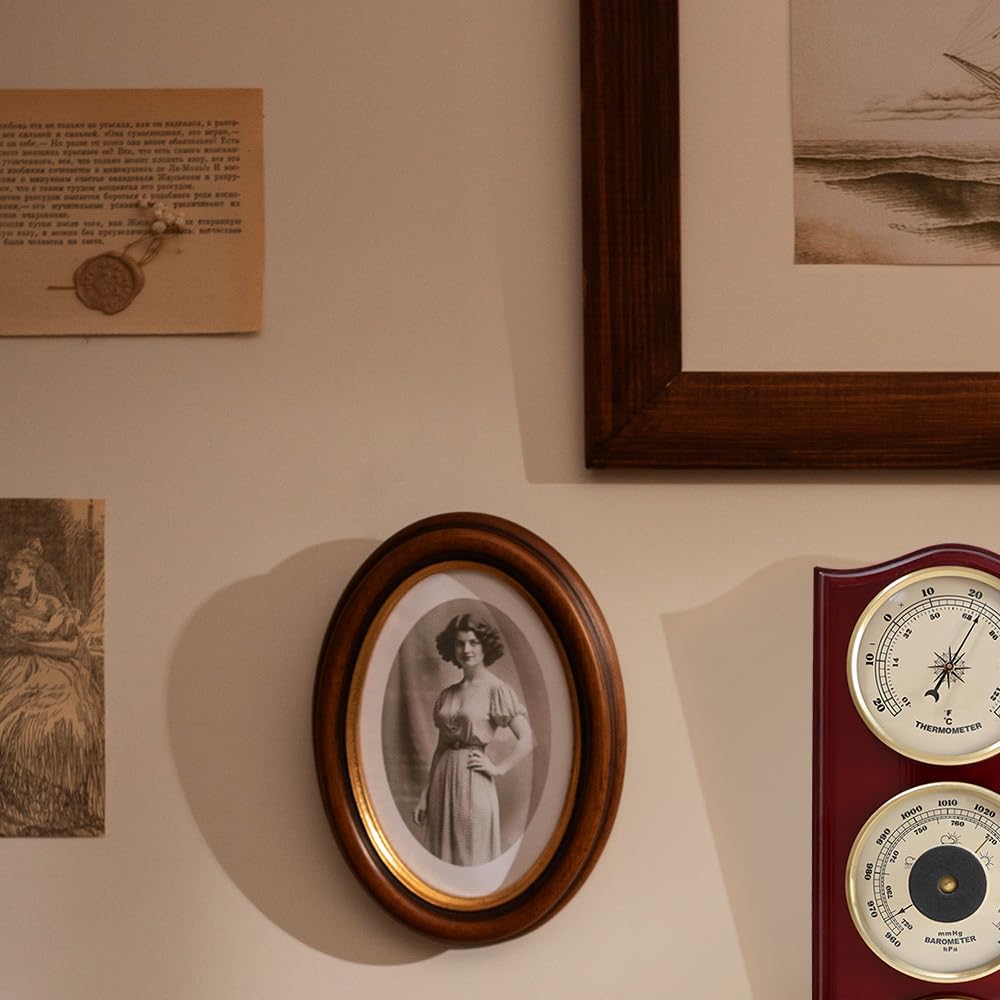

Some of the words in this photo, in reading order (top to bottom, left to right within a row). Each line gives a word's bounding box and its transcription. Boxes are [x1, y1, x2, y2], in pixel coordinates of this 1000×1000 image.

[921, 586, 935, 598] 10
[967, 588, 984, 600] 20
[883, 613, 893, 622] 0
[929, 612, 941, 621] 50
[865, 653, 875, 666] 10
[892, 657, 900, 668] 14
[872, 697, 886, 713] 20
[915, 720, 982, 734] THERMOMETER
[938, 799, 958, 807] 1010
[901, 805, 923, 820] 1000
[974, 803, 996, 818] 1020
[875, 828, 891, 846] 990
[914, 825, 928, 836] 750
[889, 850, 899, 863] 740
[864, 863, 874, 880] 980
[866, 900, 878, 918] 970
[884, 931, 902, 948] 960
[924, 935, 977, 945] BAROMETER
[937, 930, 963, 938] mmHg
